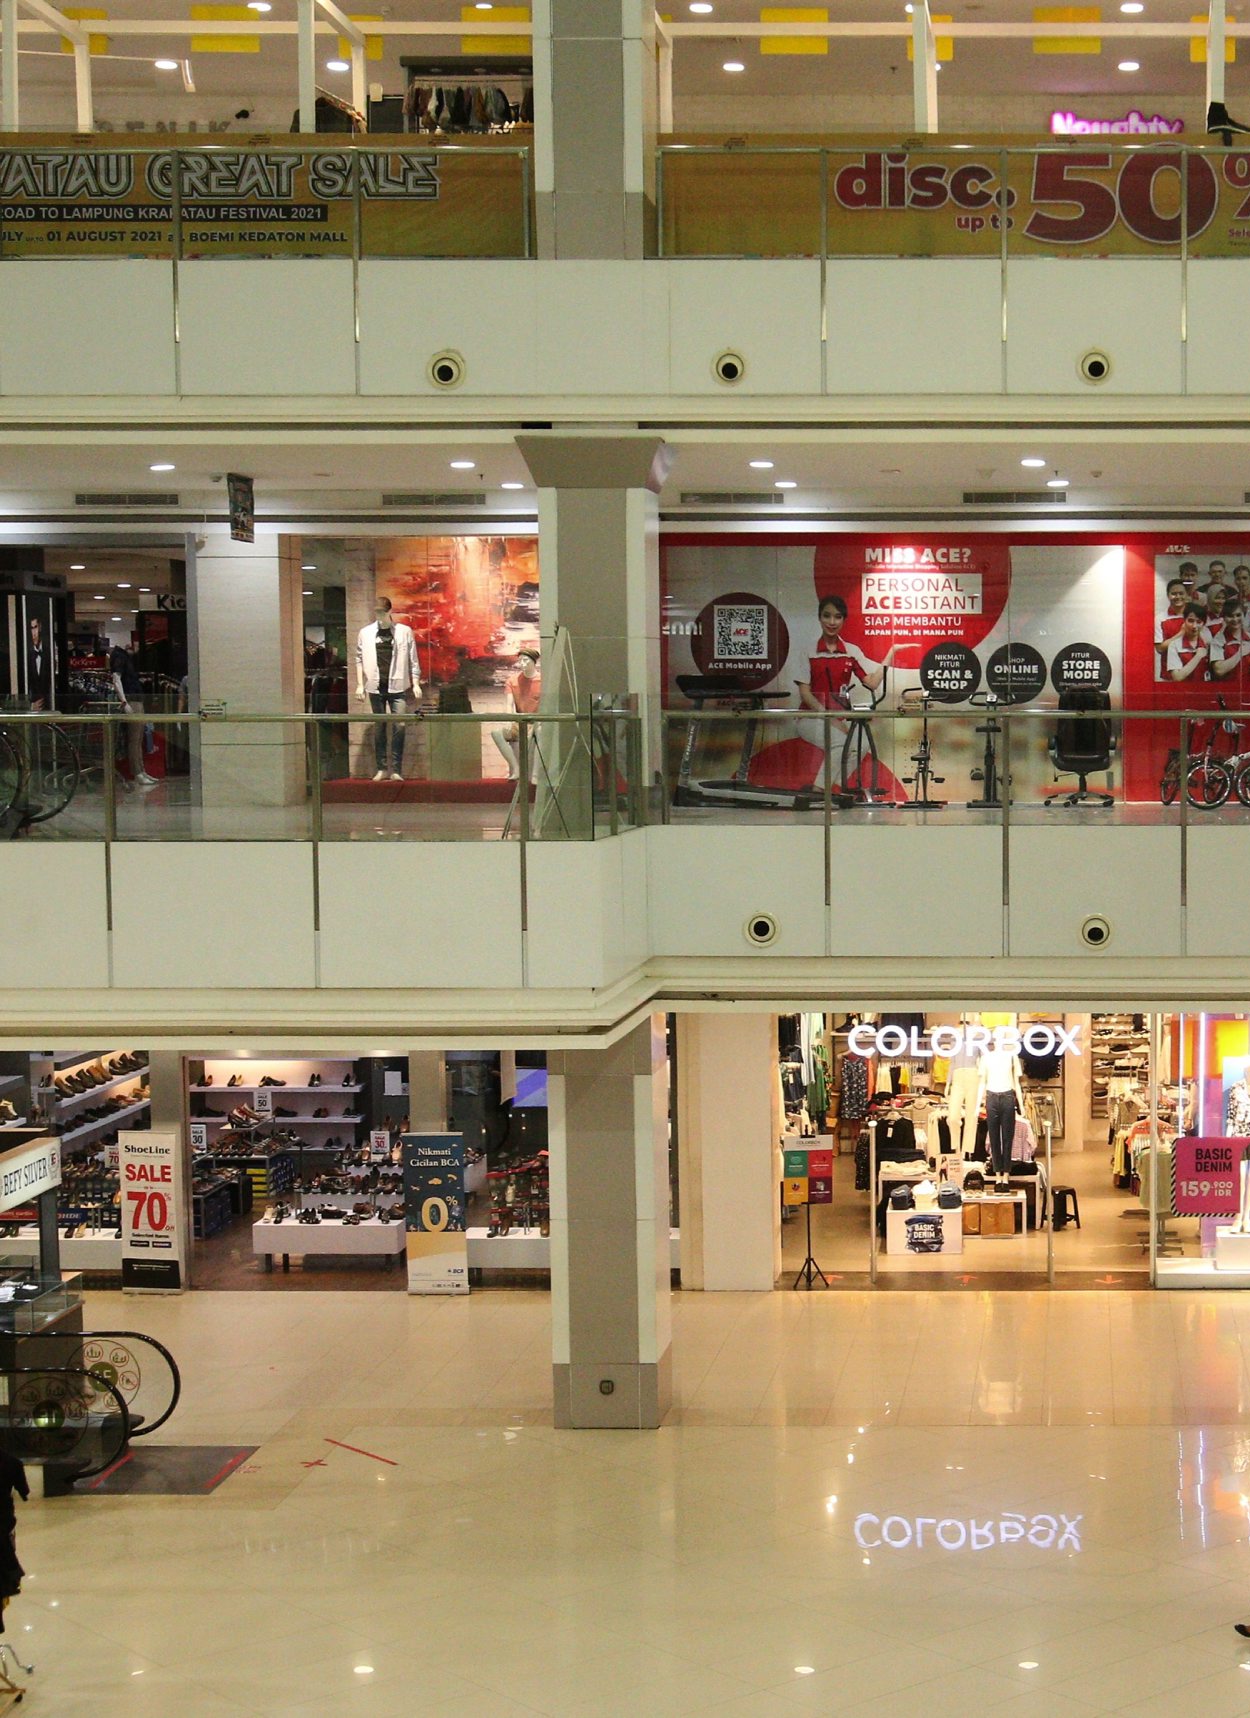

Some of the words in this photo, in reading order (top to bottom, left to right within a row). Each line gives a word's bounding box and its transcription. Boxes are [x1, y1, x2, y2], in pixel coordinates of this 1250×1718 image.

[0, 154, 134, 199] ATAU
[145, 153, 303, 199] GREAT
[309, 153, 440, 199] SALE
[39, 207, 59, 219] TO
[63, 207, 134, 219] LAMPUNG
[220, 207, 286, 219] FESTIVAL
[290, 207, 322, 219] 2021
[956, 215, 985, 233] up
[47, 232, 61, 242] 01
[66, 231, 126, 242] AUGUST
[131, 231, 162, 242] 2021
[189, 232, 234, 242] BOEMI
[239, 232, 306, 242] KEDATON
[310, 232, 347, 242] MALL
[920, 547, 971, 563] ACE?
[865, 578, 964, 592] PERSONAL
[865, 596, 978, 609] ACESISTANT
[865, 616, 890, 626] SIAP
[894, 616, 961, 626] MEMBANTU
[893, 629, 911, 637] PUN,
[755, 662, 772, 670] App
[994, 665, 1039, 674] ONLINE
[1062, 660, 1100, 670] STORE
[927, 669, 961, 680] SCAN
[964, 669, 973, 680] &
[1063, 671, 1099, 680] MODE
[933, 680, 968, 690] SHOP
[848, 1025, 1082, 1057] COLORBOX
[192, 1134, 203, 1144] 30
[124, 1145, 171, 1154] ShoeLine
[418, 1147, 451, 1156] Nikmati
[1195, 1148, 1232, 1160] BASIC
[410, 1158, 438, 1167] Cicilan
[441, 1158, 460, 1167] BCA
[1195, 1161, 1232, 1172] DENIM
[4, 1168, 23, 1196] BEFY
[24, 1158, 48, 1187] SILVER
[125, 1163, 172, 1182] SALE
[1215, 1189, 1232, 1197] IDR
